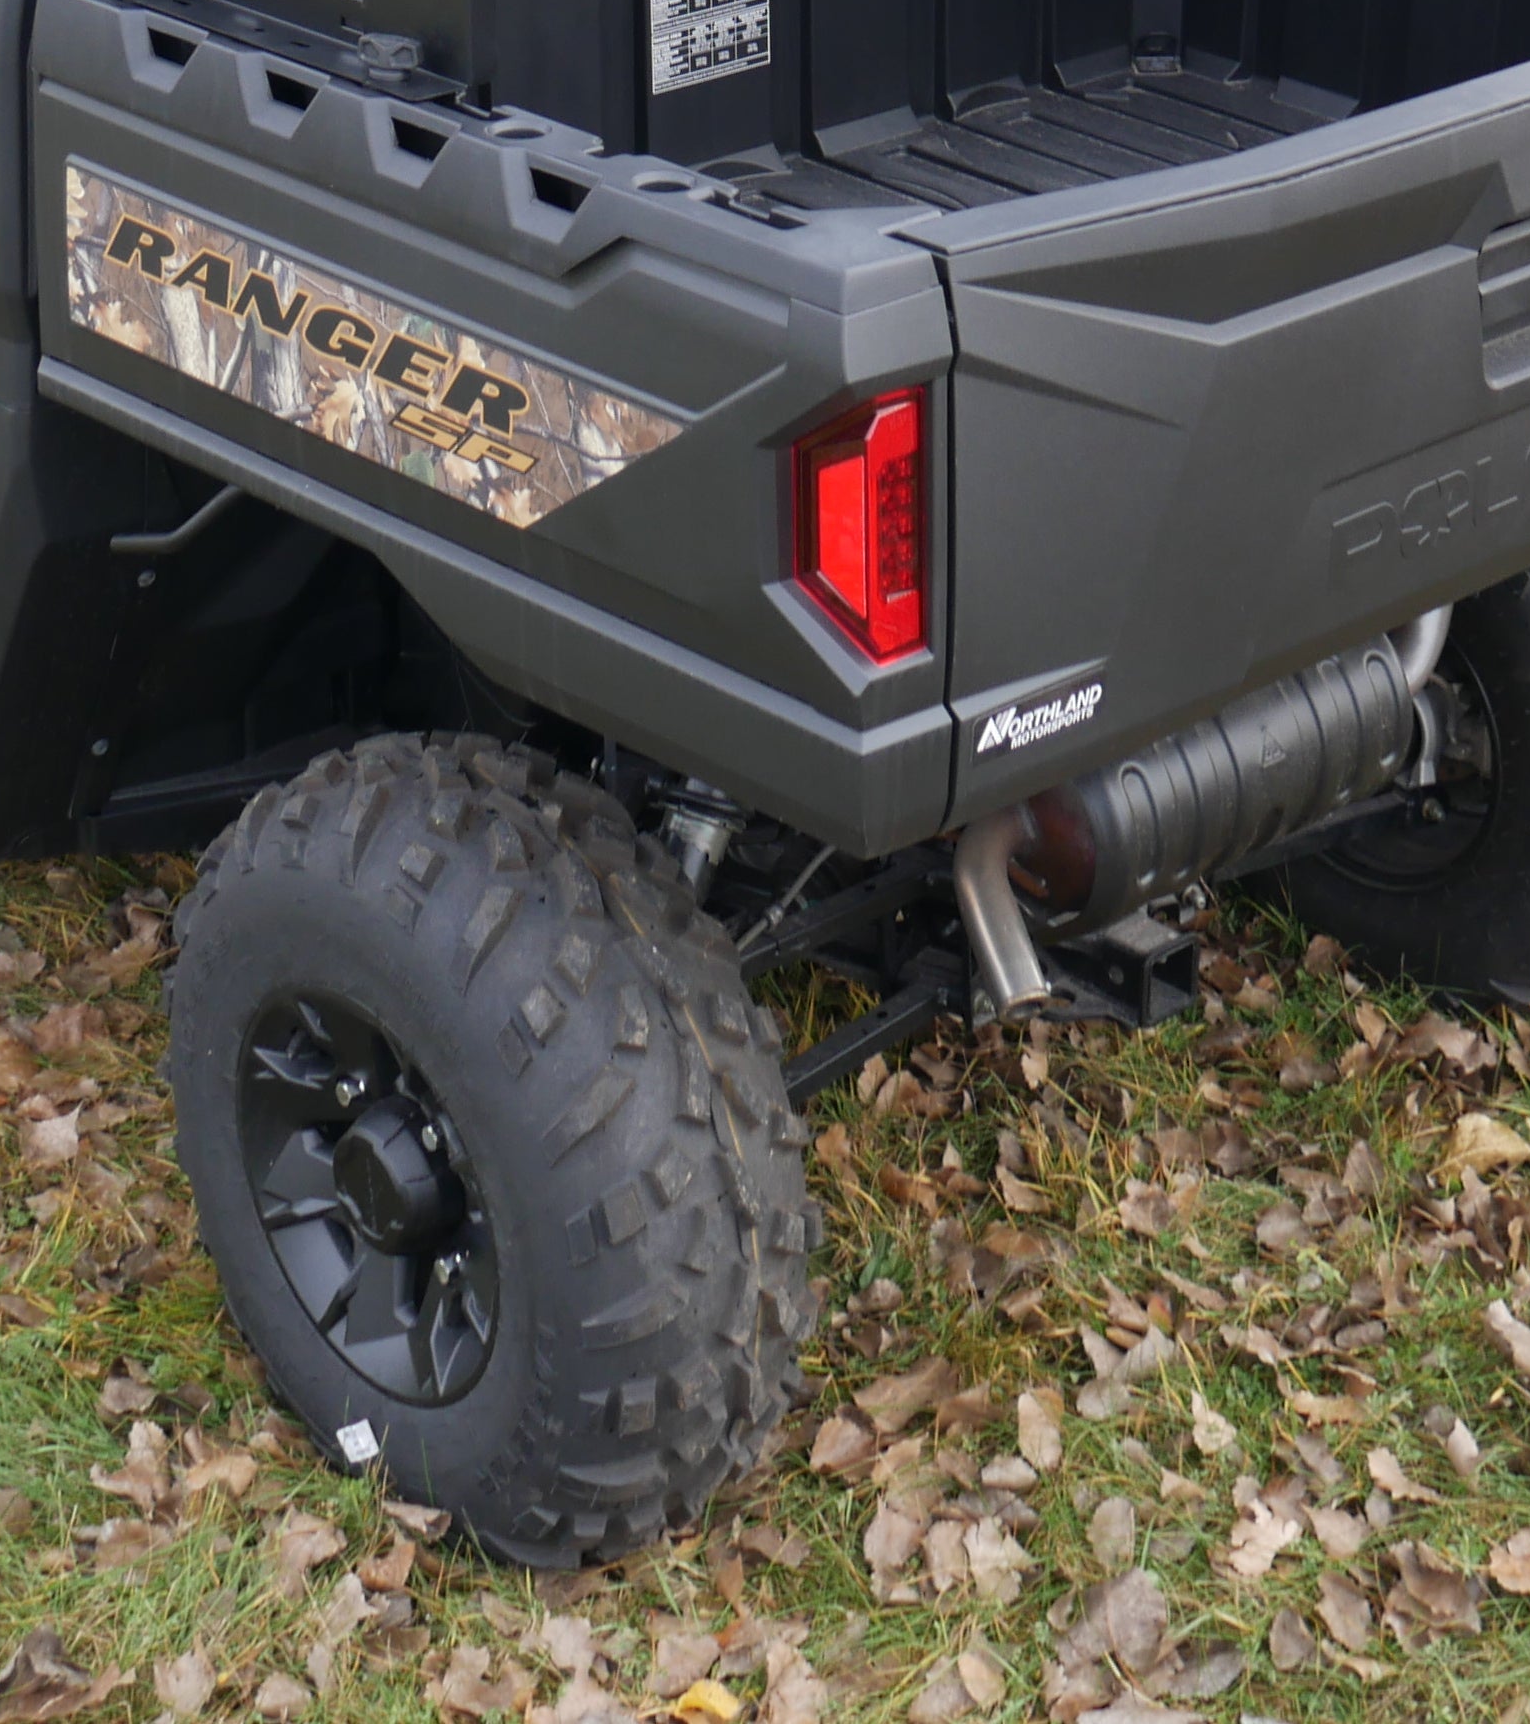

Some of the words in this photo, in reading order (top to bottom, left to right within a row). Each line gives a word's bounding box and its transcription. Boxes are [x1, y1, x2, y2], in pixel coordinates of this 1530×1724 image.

[104, 214, 531, 438] RANGER
[391, 404, 538, 474] SP
[977, 684, 1103, 753] NORTHLAND
[1010, 704, 1094, 751] MOTORSPORTS
